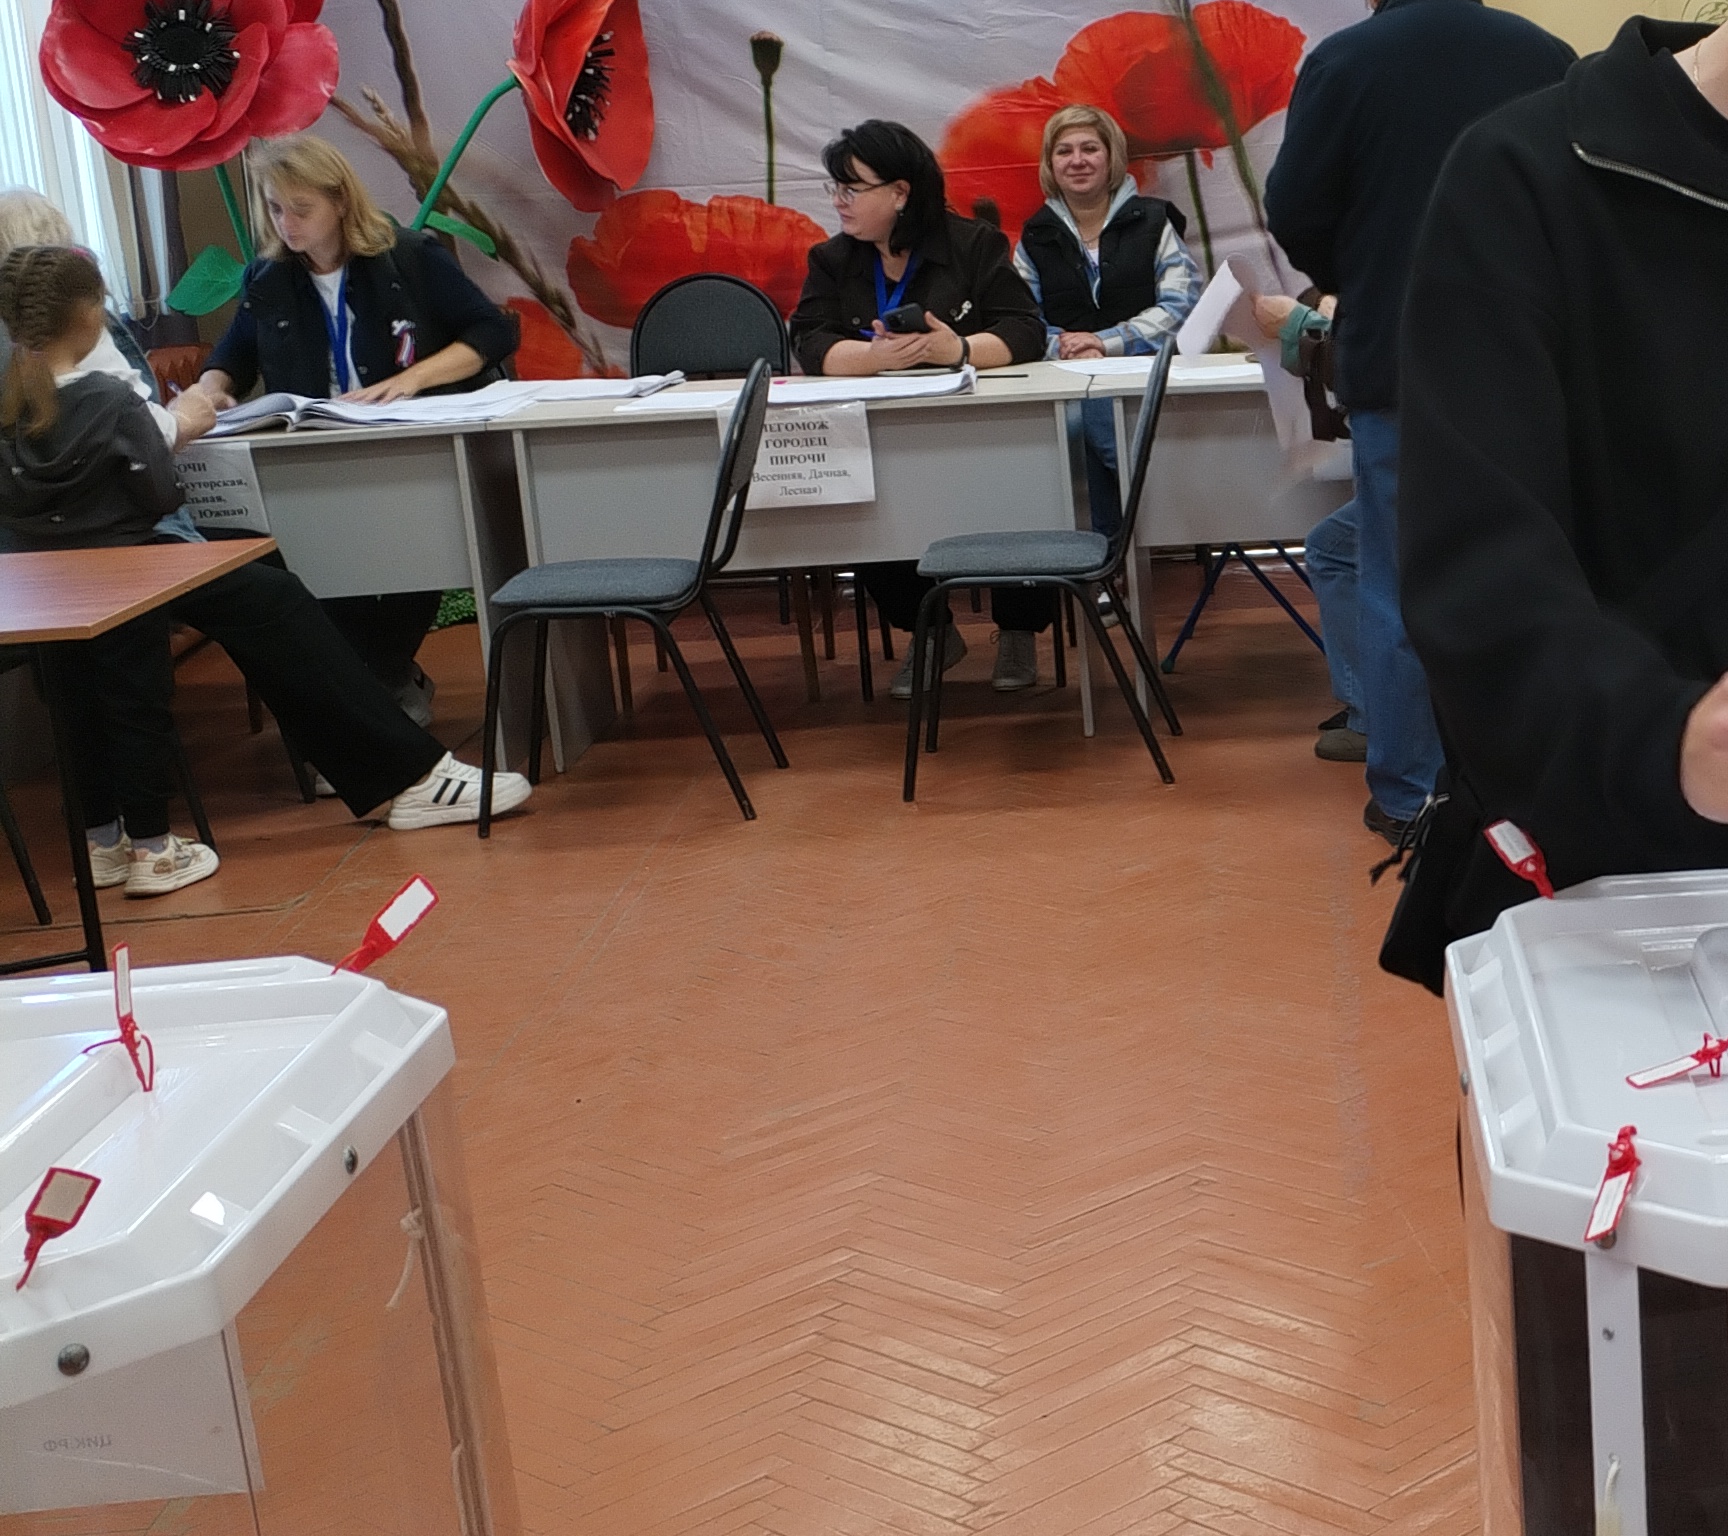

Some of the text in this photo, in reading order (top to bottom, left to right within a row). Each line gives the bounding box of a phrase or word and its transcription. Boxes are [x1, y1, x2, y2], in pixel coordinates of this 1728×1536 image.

[764, 437, 828, 449] ГОРОДЕЦ
[769, 453, 826, 466] ПИРОЧИ
[809, 468, 851, 480] Дачная,
[779, 485, 823, 496] Лесная)
